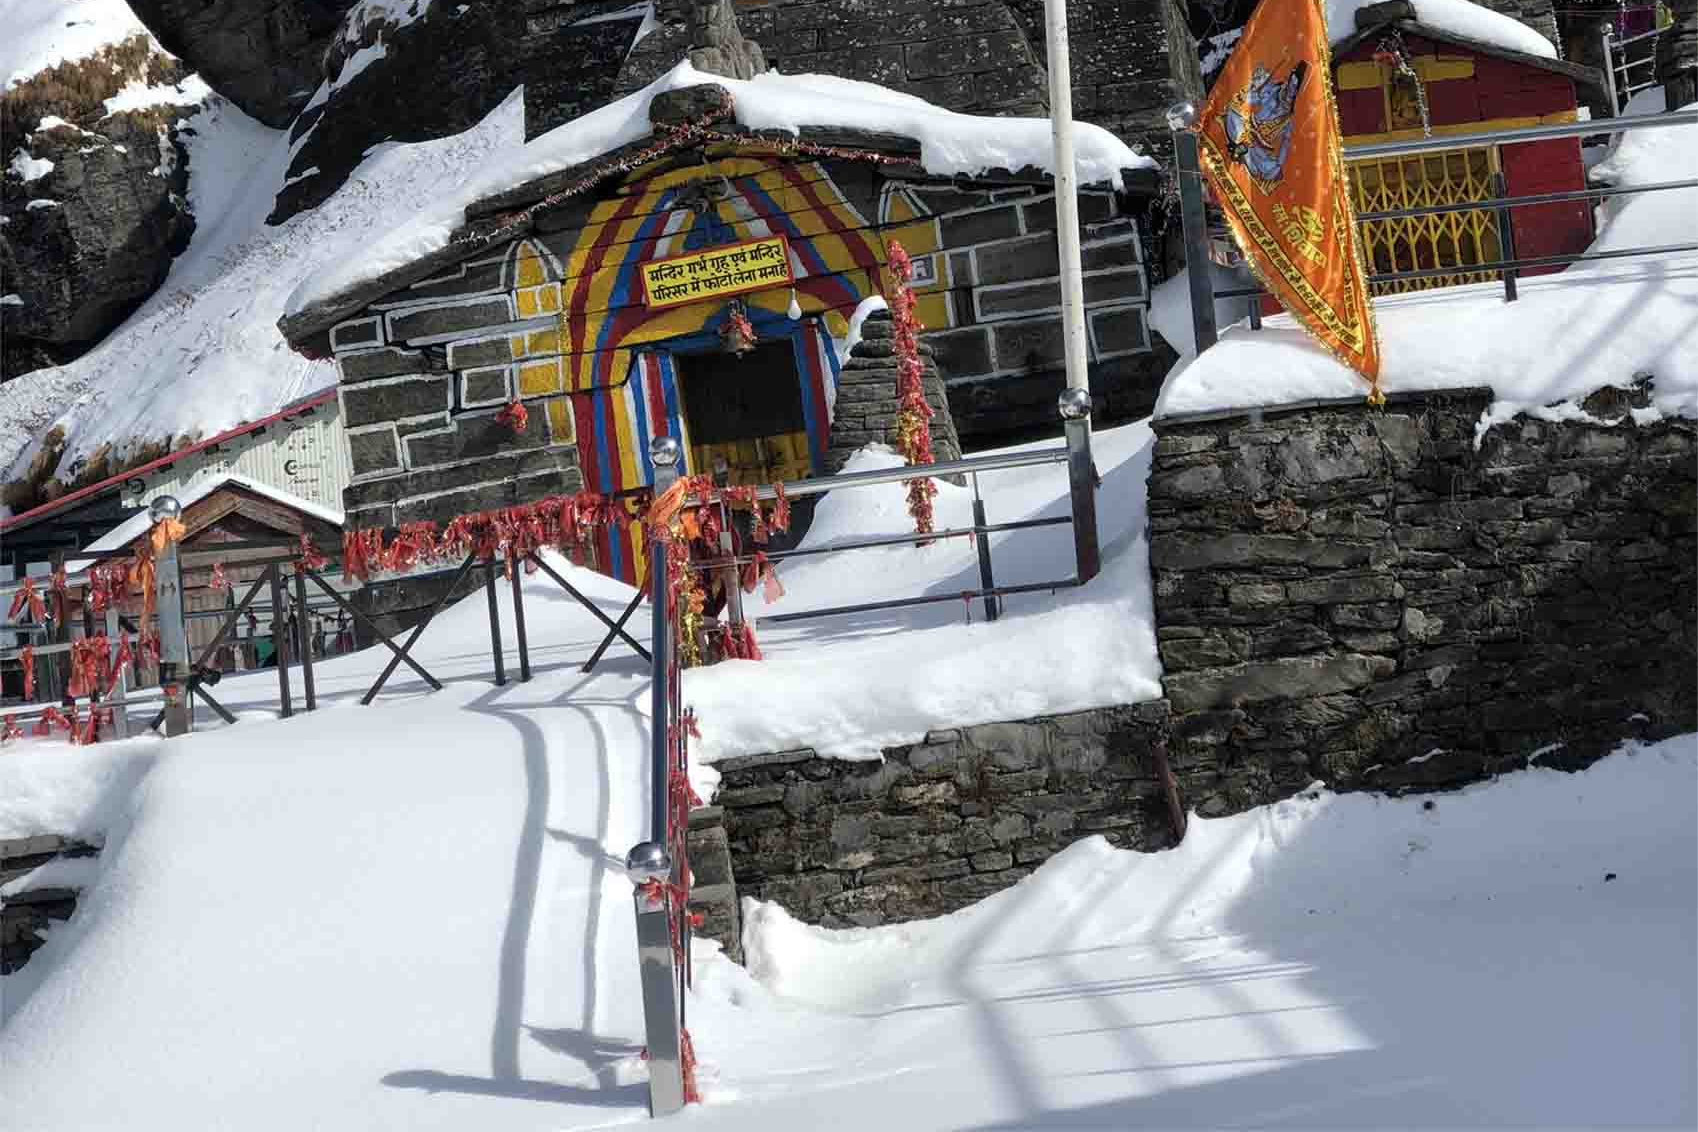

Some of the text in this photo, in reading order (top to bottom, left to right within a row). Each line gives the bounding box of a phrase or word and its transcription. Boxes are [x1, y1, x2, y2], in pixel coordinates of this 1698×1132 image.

[648, 243, 784, 281] मन्दिर गर्भ गृह एवं मन्दिर
[651, 284, 688, 300] परिसर
[689, 276, 701, 292] में
